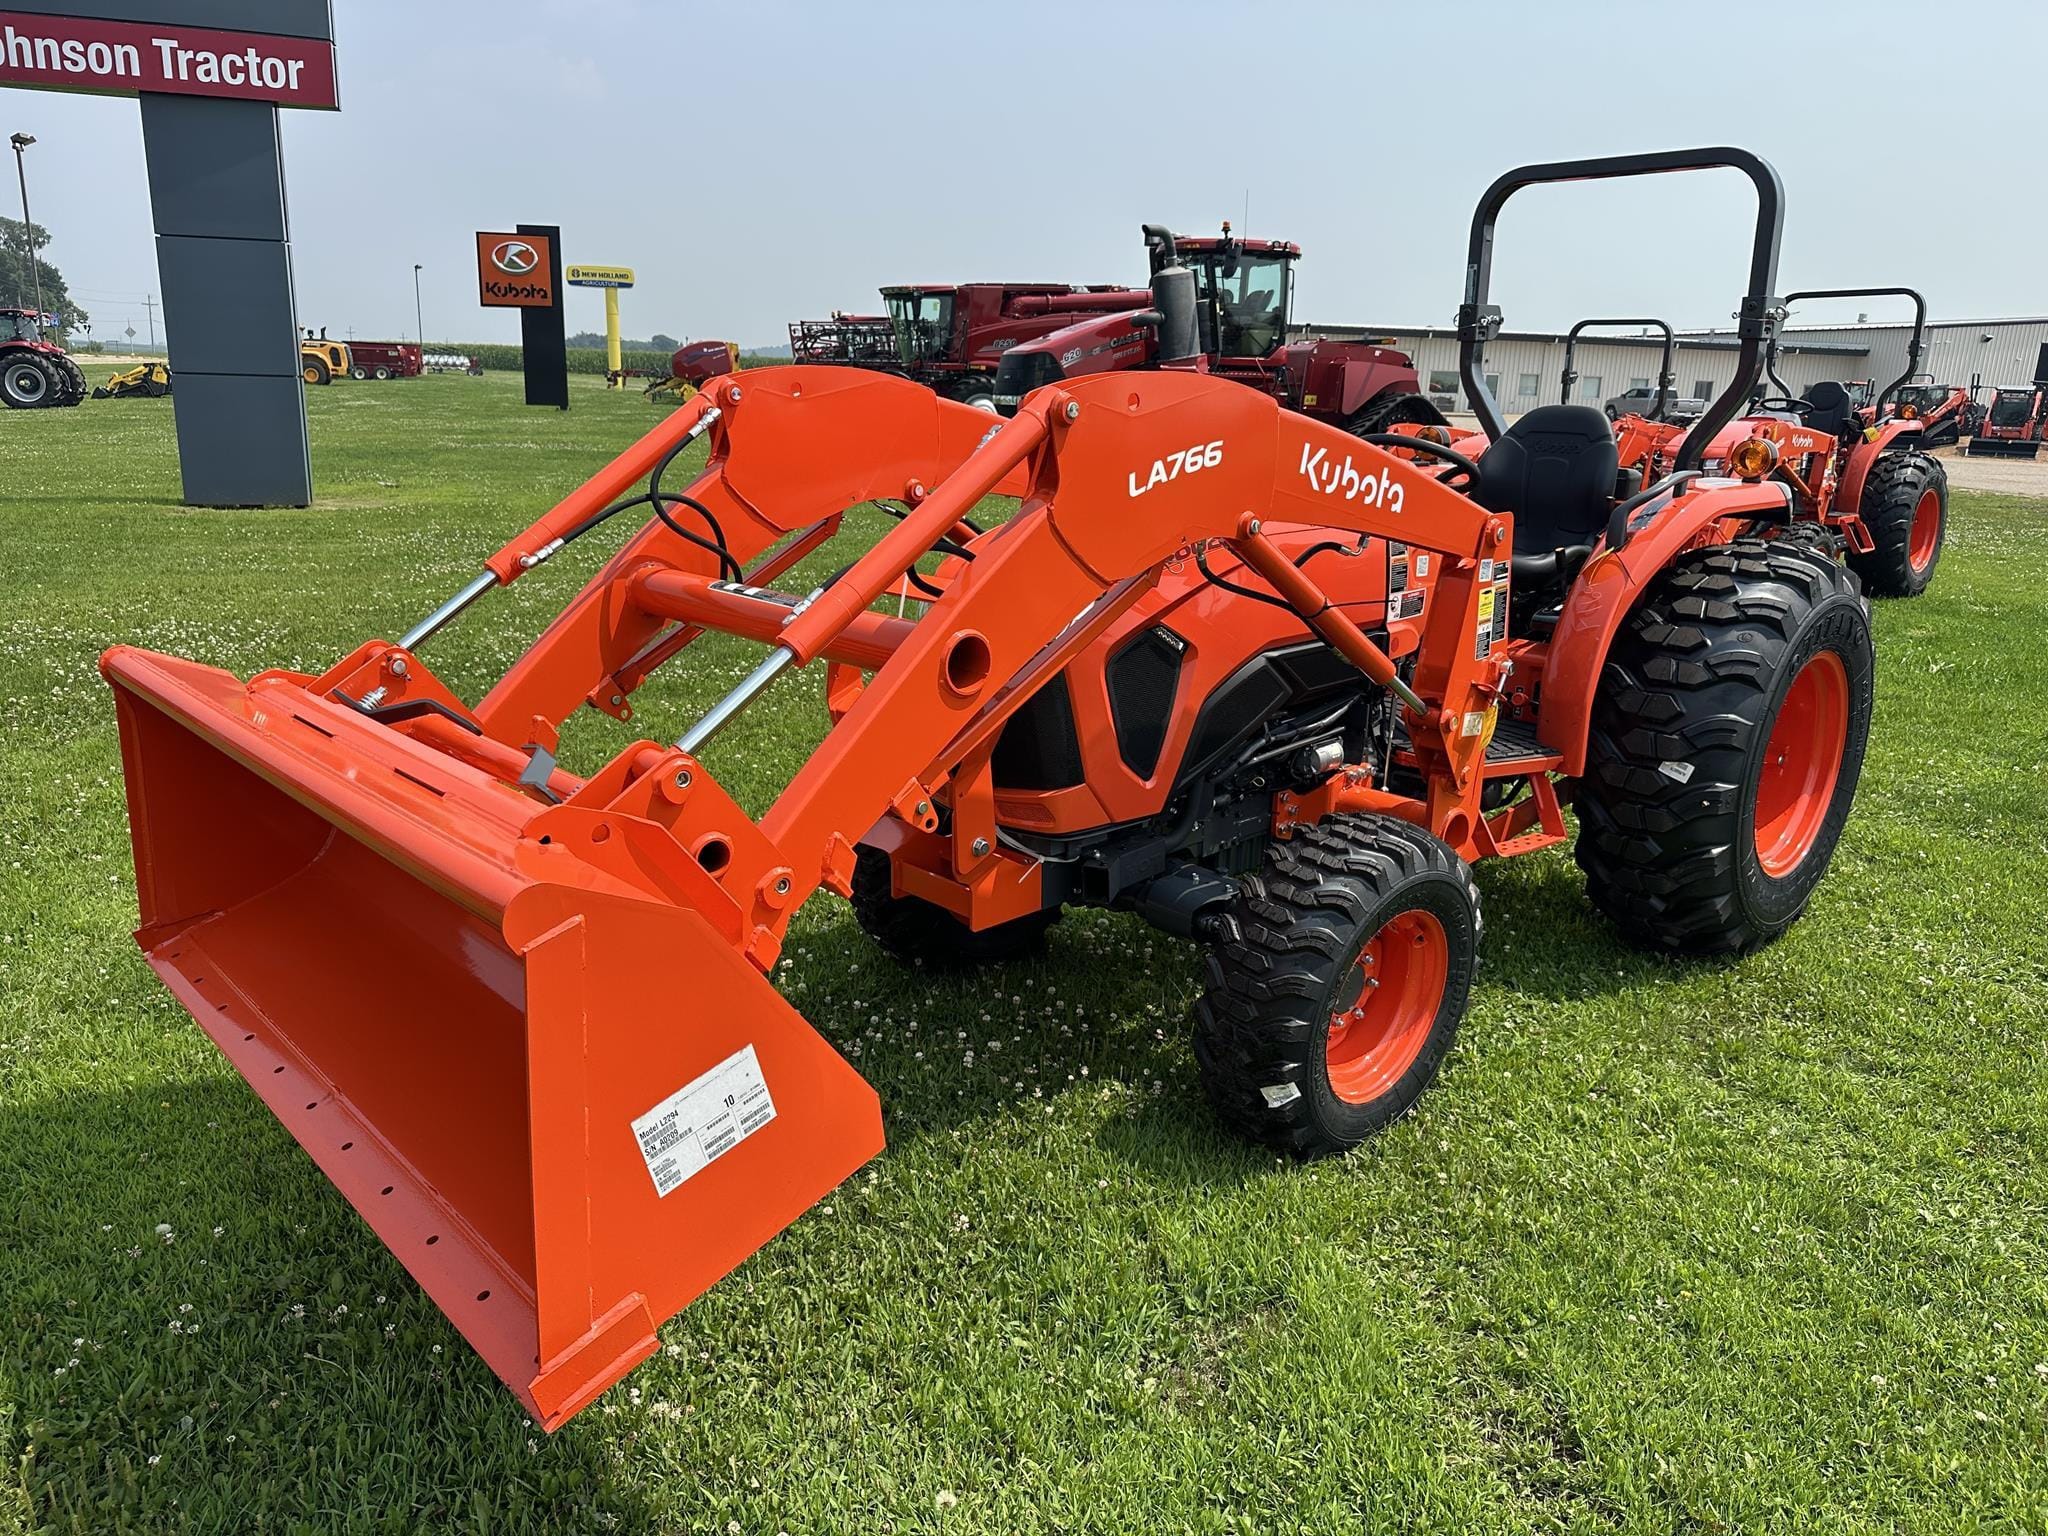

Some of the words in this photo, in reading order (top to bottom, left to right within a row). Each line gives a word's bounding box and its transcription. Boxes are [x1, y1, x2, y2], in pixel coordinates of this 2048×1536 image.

[0, 26, 141, 77] hnson
[151, 38, 304, 90] Tractor
[581, 271, 598, 279] NEW
[598, 272, 629, 280] HOLLAND
[485, 281, 548, 299] Kubota
[581, 280, 619, 288] AGRICULTURE
[1110, 332, 1140, 347] CASE
[1062, 347, 1082, 361] 620
[1791, 433, 1814, 448] Kubota
[1128, 440, 1224, 498] LA766
[1299, 442, 1405, 513] Kubota
[723, 1094, 735, 1108] 10
[639, 1123, 659, 1139] Model
[659, 1110, 679, 1126] L2294
[644, 1144, 657, 1157] S/N
